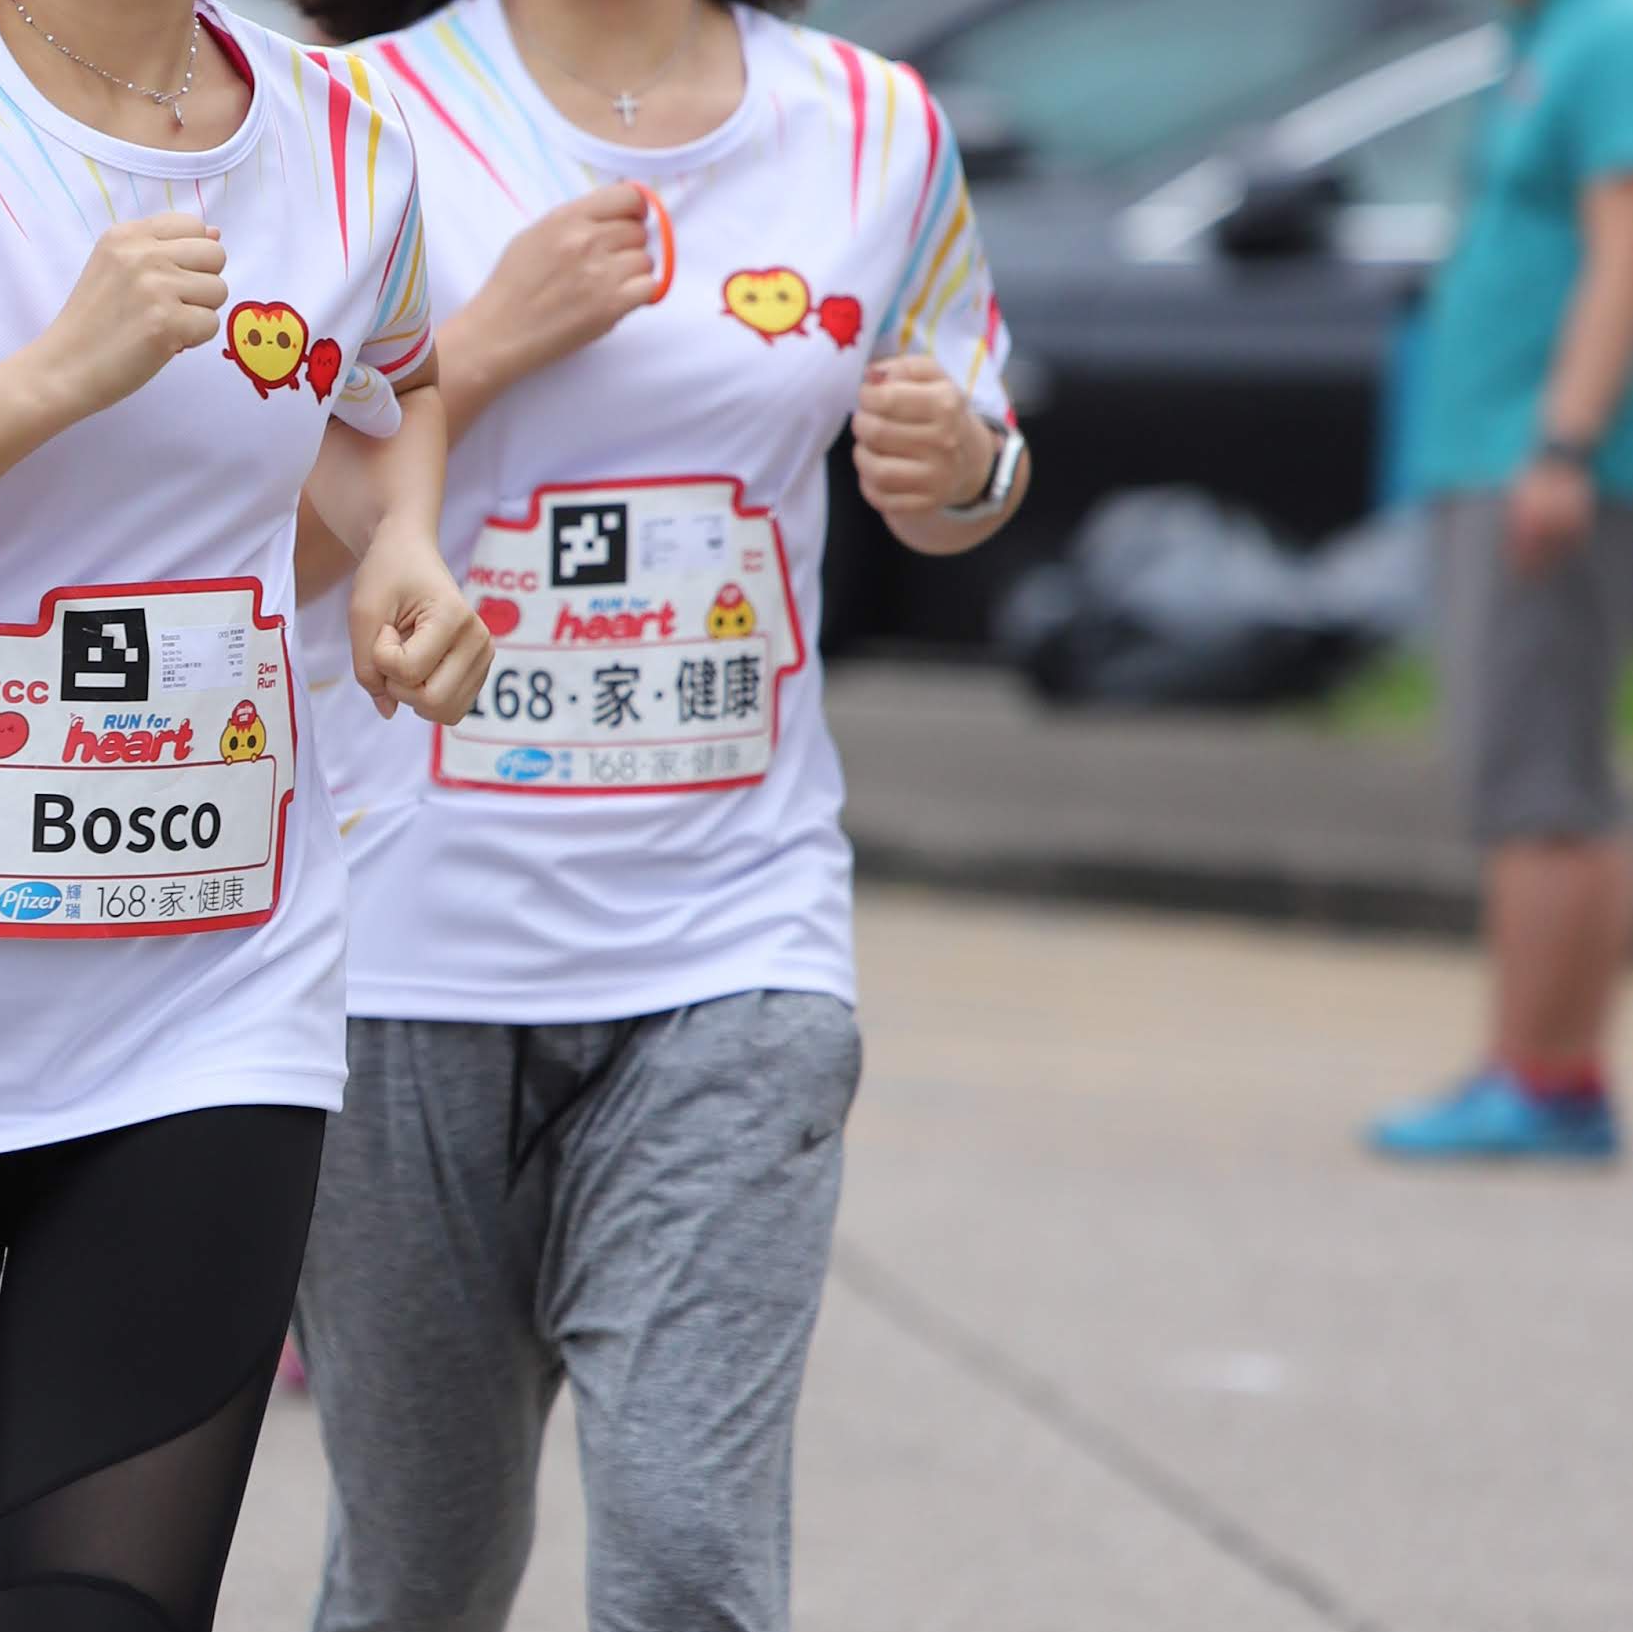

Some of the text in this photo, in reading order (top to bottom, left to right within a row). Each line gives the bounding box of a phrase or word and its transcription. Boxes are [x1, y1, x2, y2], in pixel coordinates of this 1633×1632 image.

[552, 600, 675, 642] heart
[257, 662, 277, 675] 2km
[257, 677, 276, 689] Run
[465, 654, 760, 728] 68·家·健康
[62, 716, 194, 763] heart
[103, 712, 171, 729] RUN for
[32, 793, 221, 854] Bosco
[0, 884, 62, 919] Pfizer
